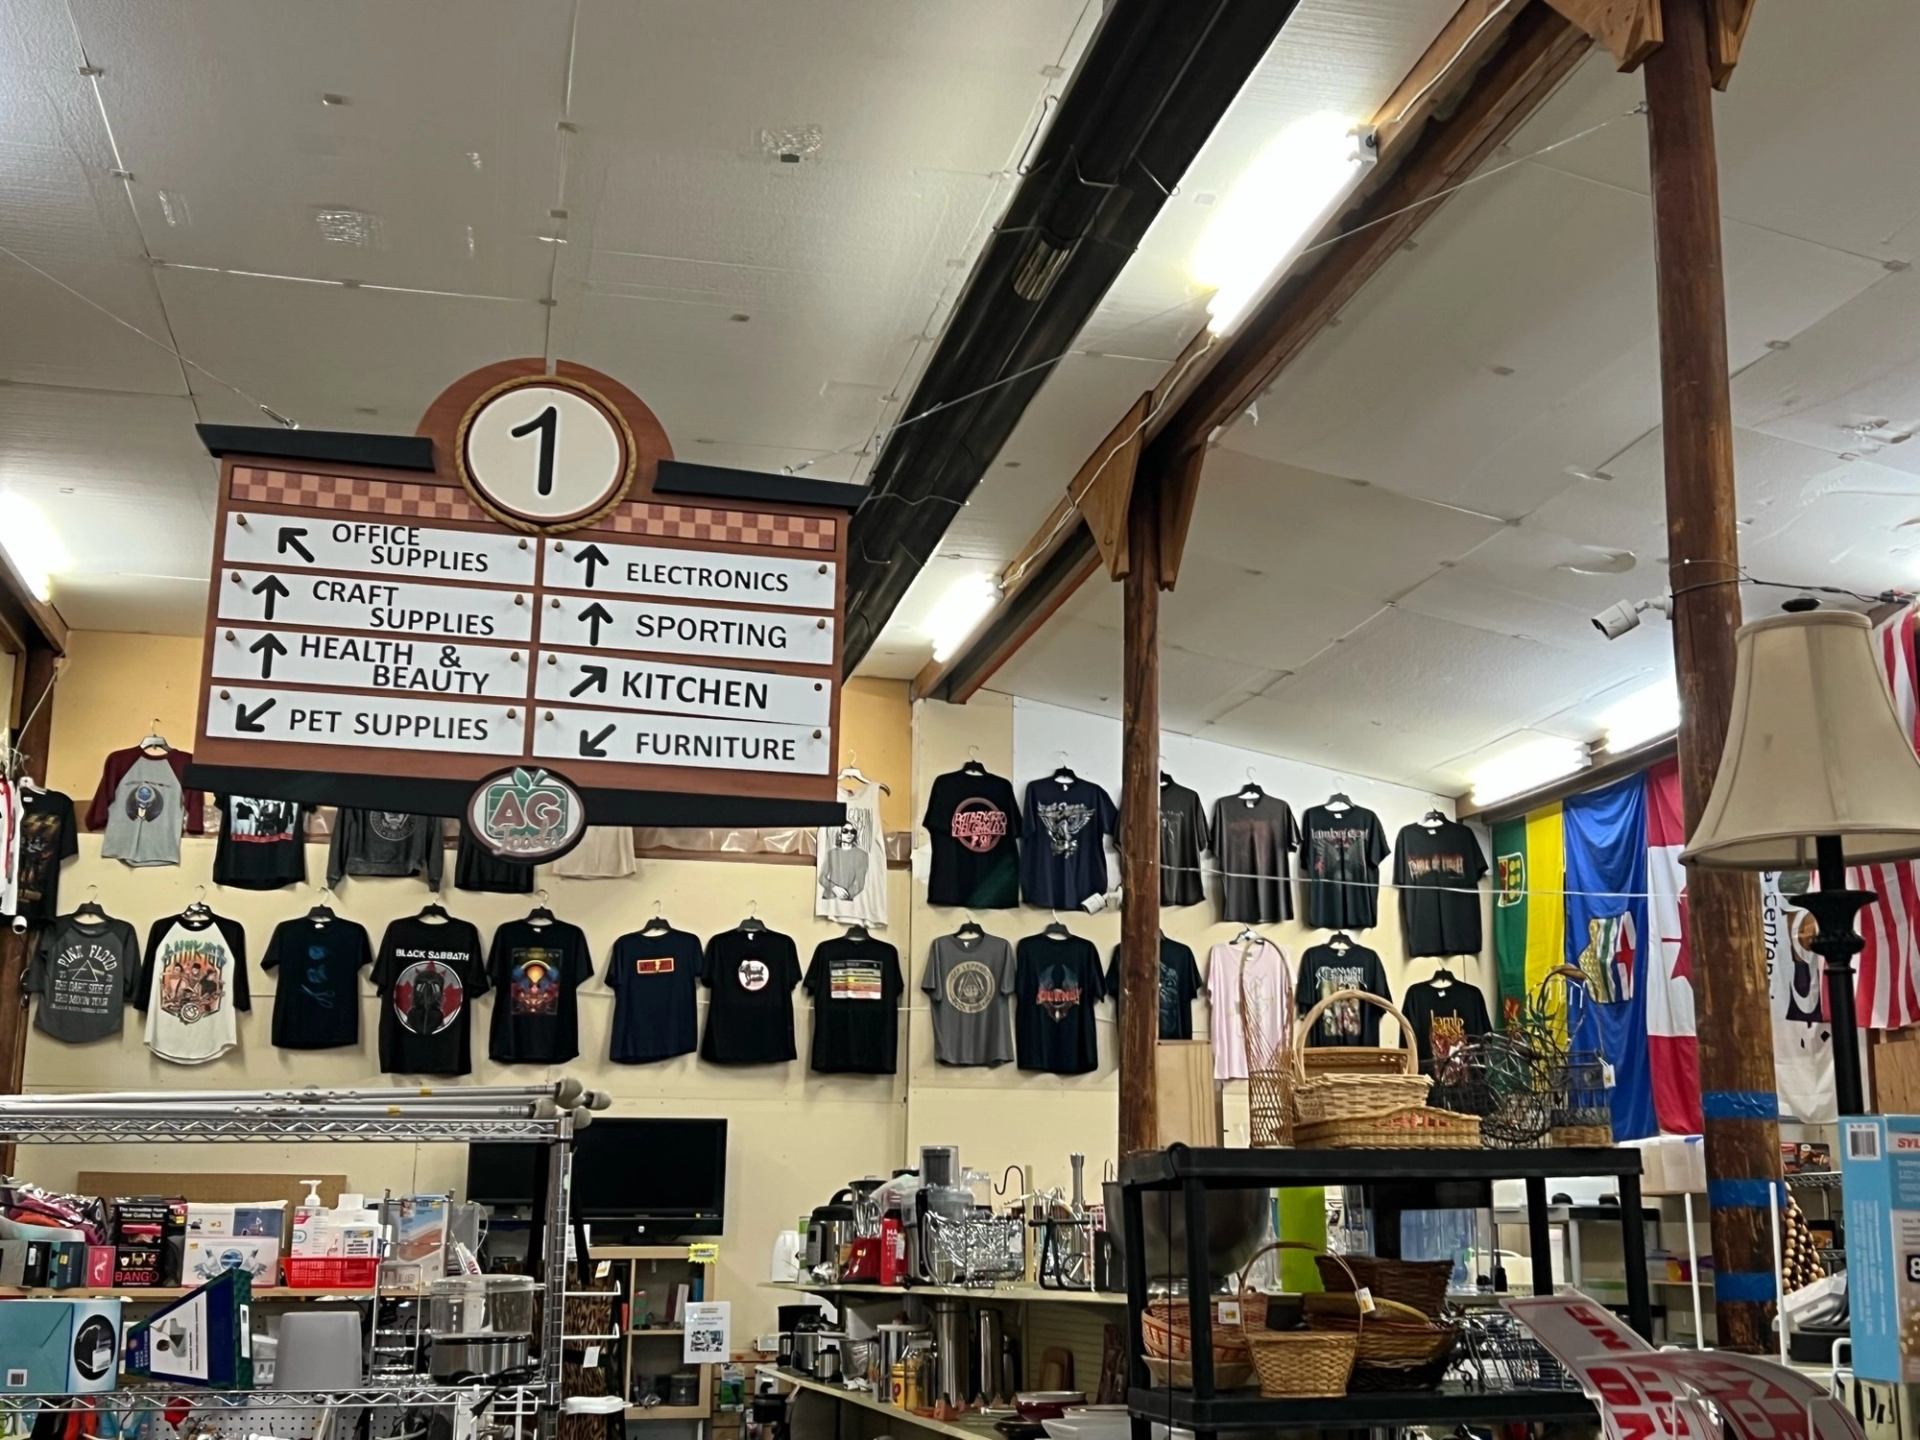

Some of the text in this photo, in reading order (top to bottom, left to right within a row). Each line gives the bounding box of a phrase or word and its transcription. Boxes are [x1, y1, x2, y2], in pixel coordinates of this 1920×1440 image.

[512, 407, 557, 496] 1
[332, 523, 420, 546] OFFICE
[370, 545, 488, 572] SUPPLIES
[627, 562, 788, 592] ELECTRONICS
[312, 580, 399, 606] CRAFT
[370, 607, 494, 636] SUPPLIES
[636, 614, 787, 649] SPORTING
[300, 635, 462, 668] HEALTH &
[373, 665, 490, 694] BEAUTY
[622, 671, 768, 709] KITCHEN
[290, 709, 488, 740] PET SUPPLIES
[636, 733, 796, 761] FURNITURE
[489, 790, 562, 830] AG
[396, 948, 470, 961] BLACK SABBATH
